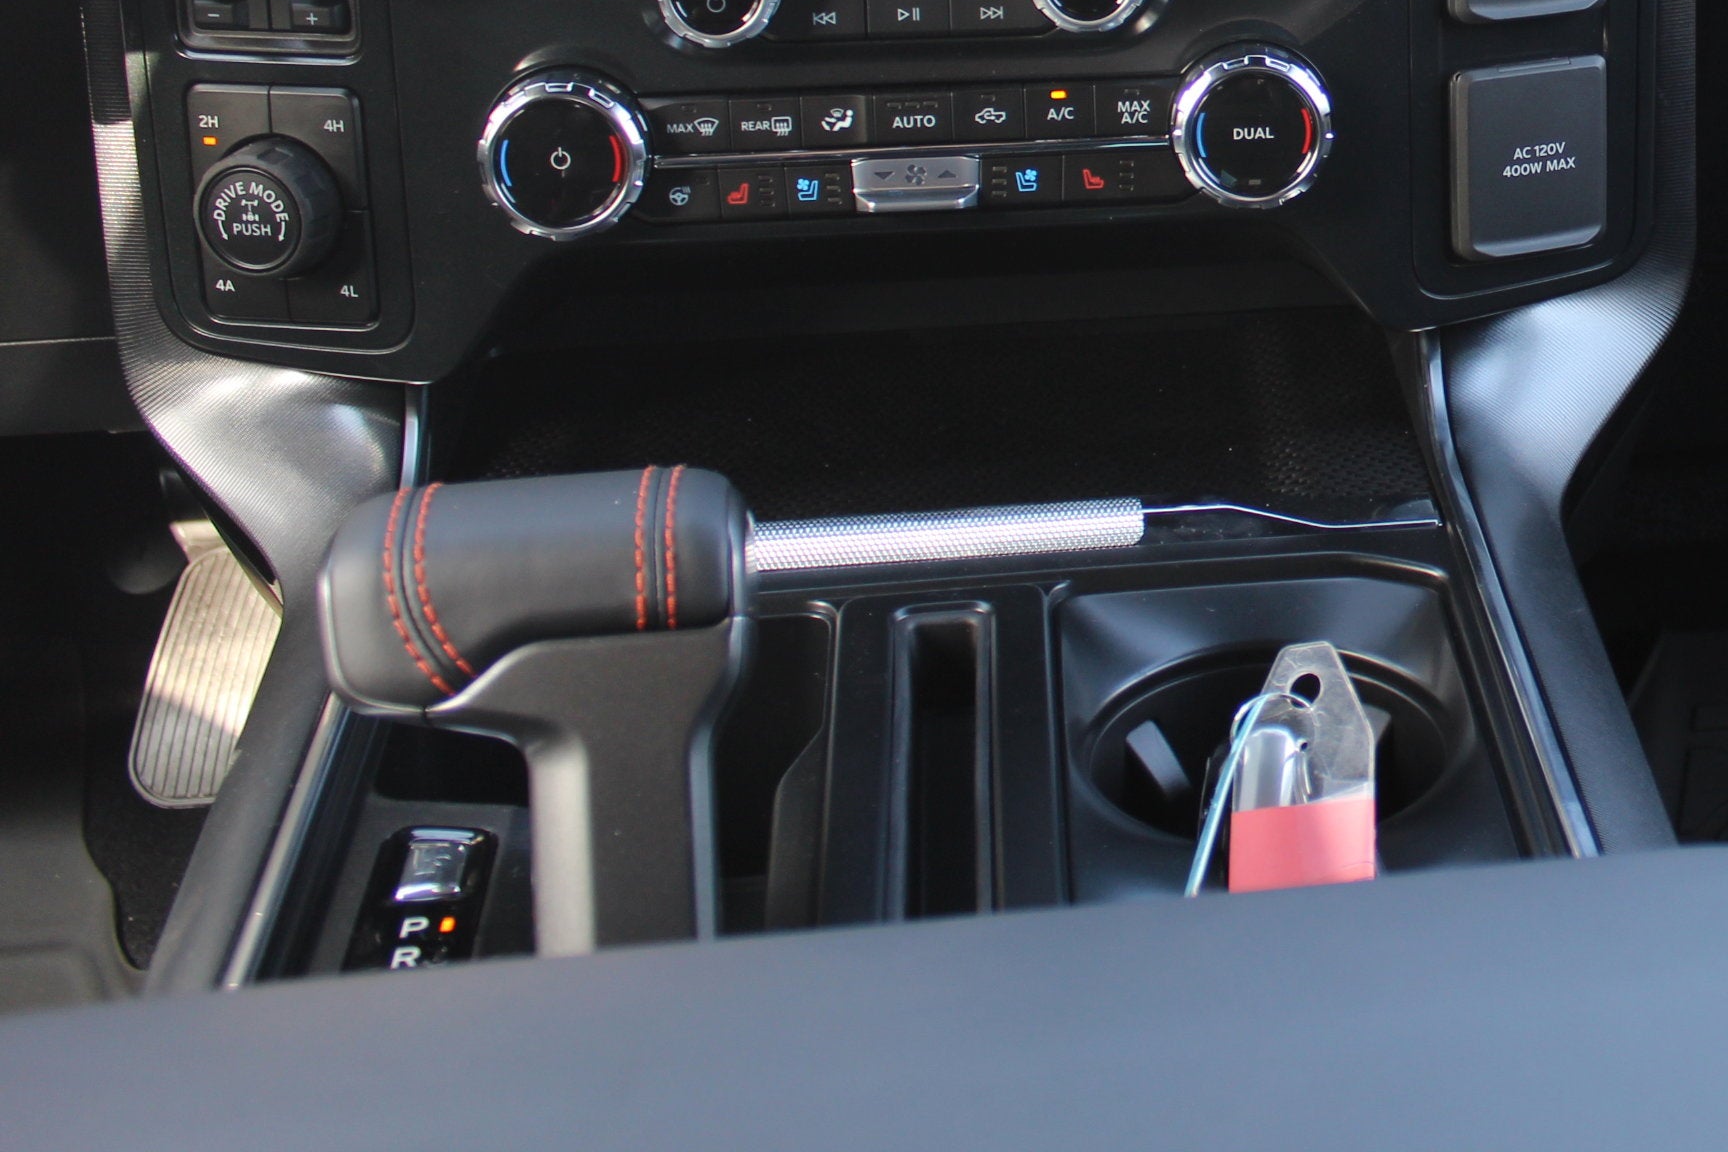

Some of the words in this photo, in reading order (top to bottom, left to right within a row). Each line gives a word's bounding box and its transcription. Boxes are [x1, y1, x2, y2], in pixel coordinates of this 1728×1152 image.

[1118, 100, 1150, 113] MAX
[1047, 107, 1074, 121] A/C
[1121, 111, 1148, 124] A/C
[199, 114, 219, 129] 2H
[323, 118, 344, 133] 4H
[667, 122, 694, 133] MAX
[741, 120, 770, 132] REAR
[893, 115, 936, 128] AUTO
[1233, 127, 1274, 140] DUAL
[1513, 146, 1532, 160] AC
[1534, 142, 1566, 157] 120V
[1503, 162, 1542, 178] 400W
[1546, 157, 1576, 173] MAX
[212, 181, 247, 221] DRIVE
[249, 182, 289, 222] MODE
[233, 222, 272, 237] PUSH
[215, 279, 235, 293] 4A
[340, 284, 358, 298] 4L
[399, 916, 430, 939] P
[389, 946, 422, 970] R
